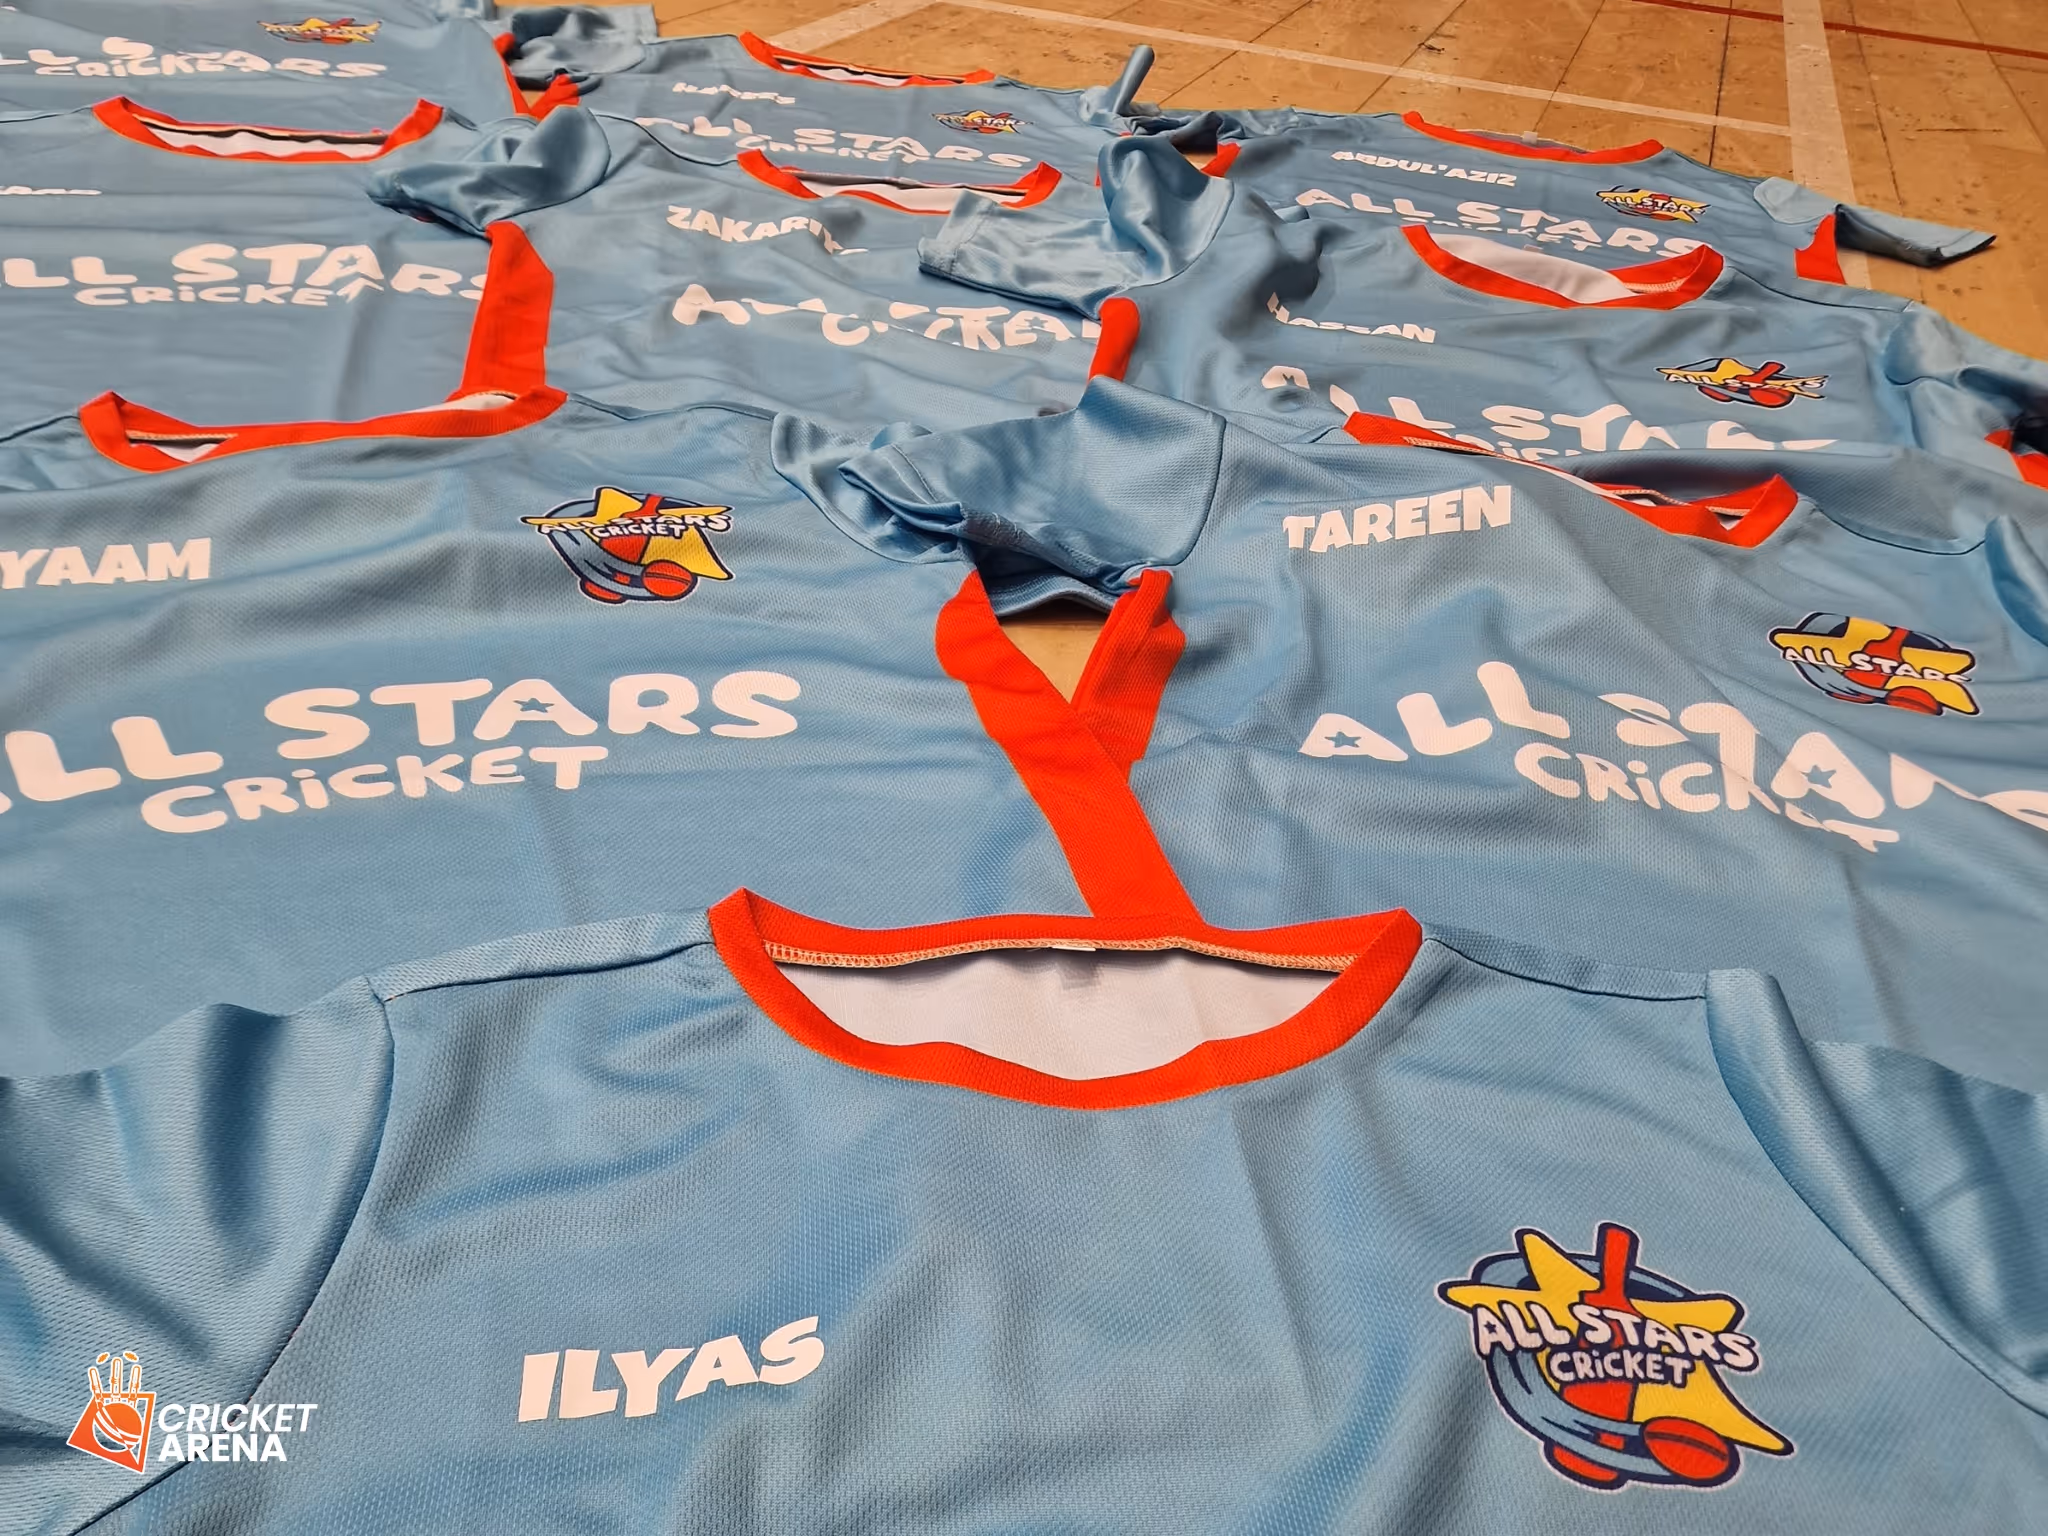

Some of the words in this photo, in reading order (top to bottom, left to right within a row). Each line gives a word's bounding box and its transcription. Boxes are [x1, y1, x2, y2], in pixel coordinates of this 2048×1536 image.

[794, 128, 1031, 168] STARS
[1331, 151, 1517, 187] ABDUL'AZIZ
[666, 205, 868, 255] ZAKARIY
[1296, 188, 1436, 219] ALL
[1457, 201, 1713, 258] STARS
[1283, 484, 1512, 553] TAREEN
[1785, 647, 1846, 668] ALL
[0, 715, 224, 814] LL
[264, 671, 802, 760] STARS
[1299, 661, 1571, 762] ALL
[518, 1315, 826, 1423] ILYAS
[1475, 1303, 1570, 1355] ALL
[1572, 1303, 1758, 1368] STARS
